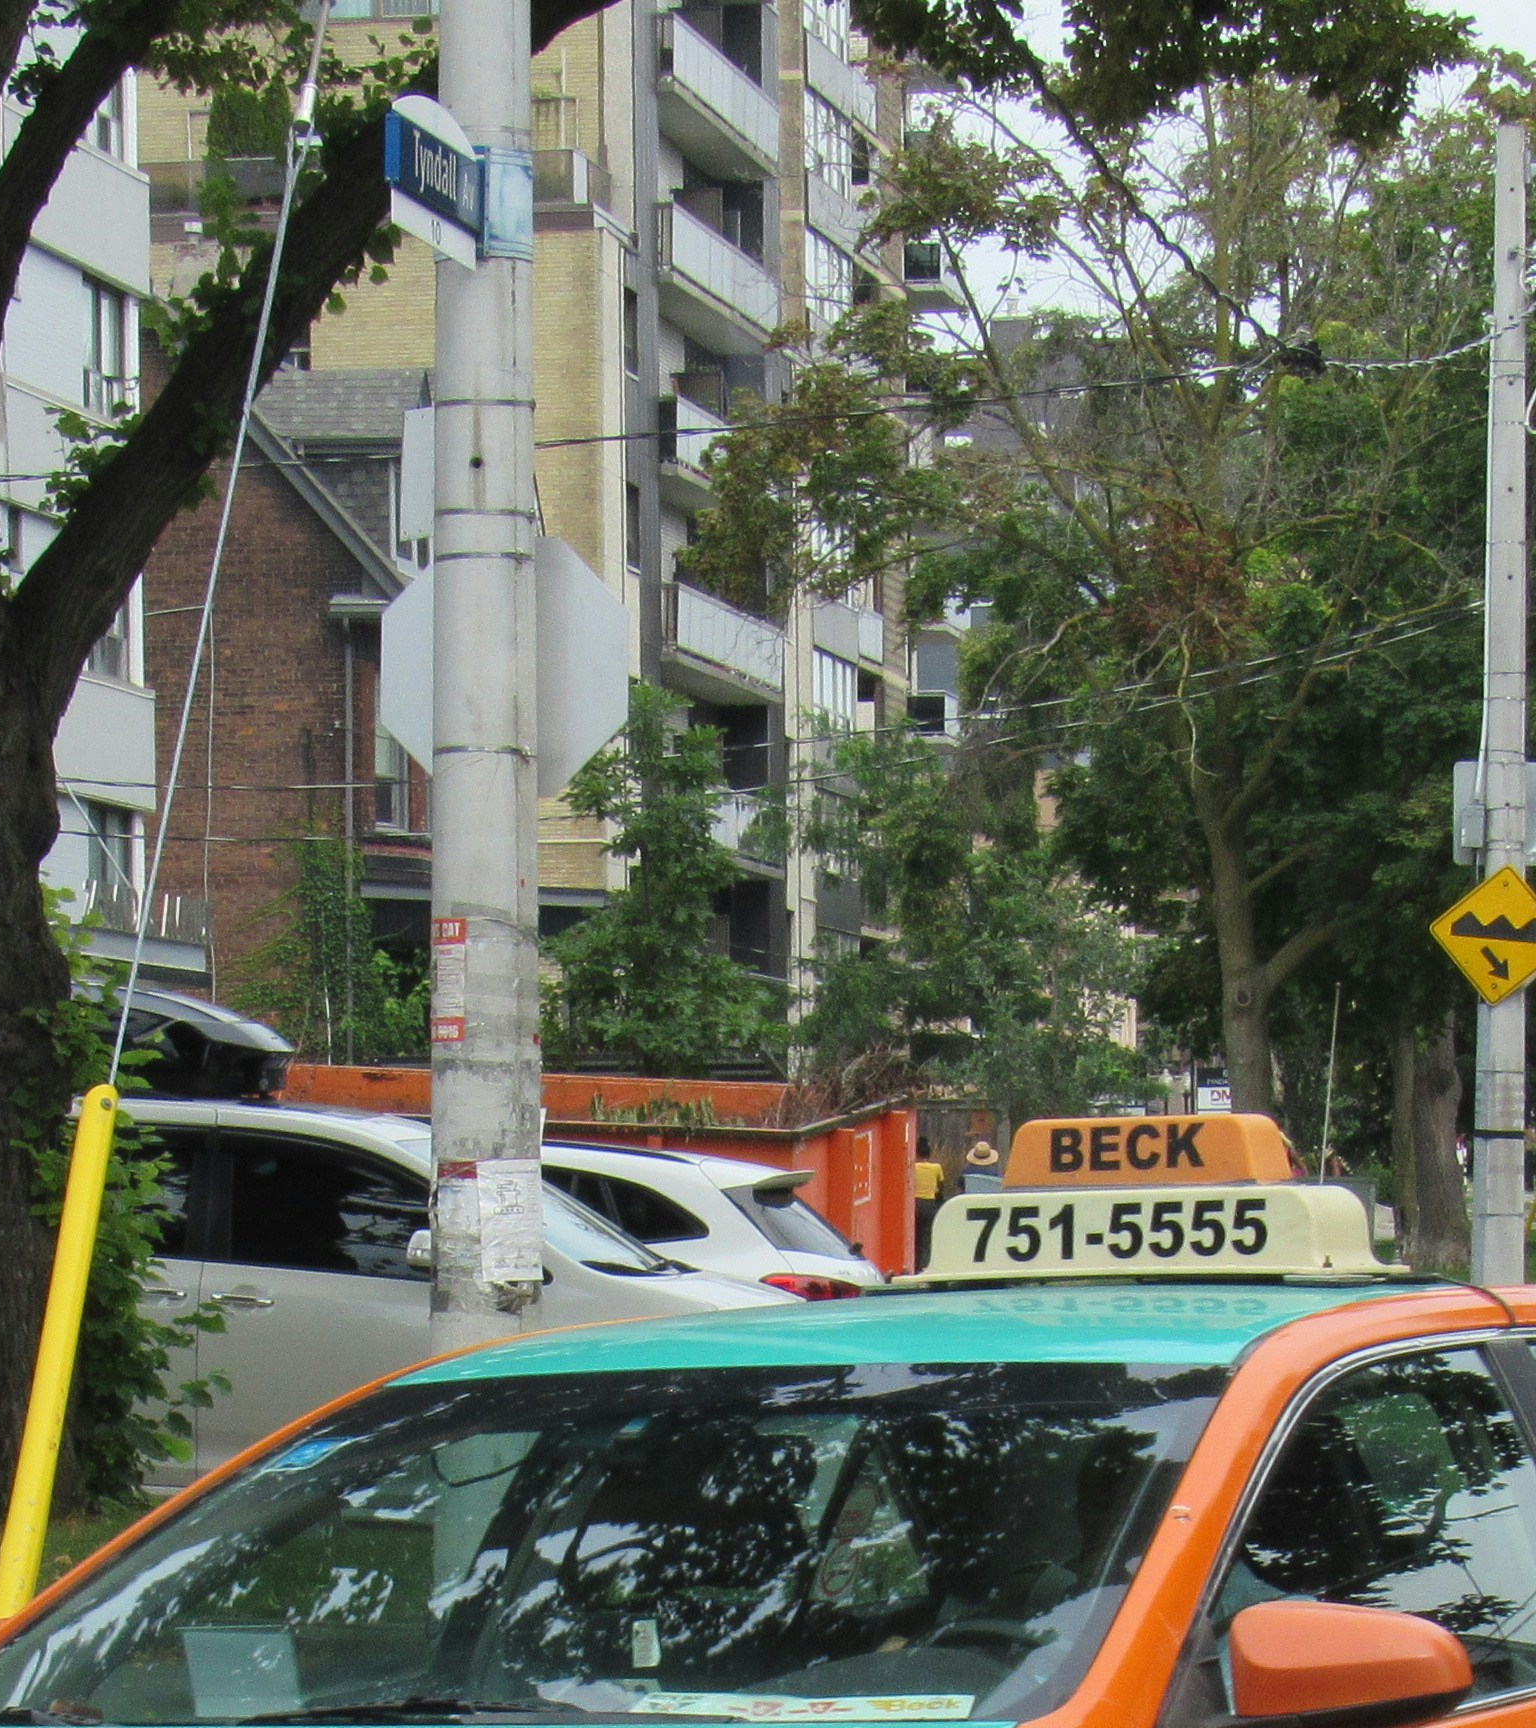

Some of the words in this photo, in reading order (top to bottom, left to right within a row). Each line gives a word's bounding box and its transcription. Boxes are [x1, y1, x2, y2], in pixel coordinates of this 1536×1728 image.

[412, 128, 457, 201] Tyndall
[1049, 1122, 1206, 1174] BECK
[965, 1197, 1269, 1264] 751-5555
